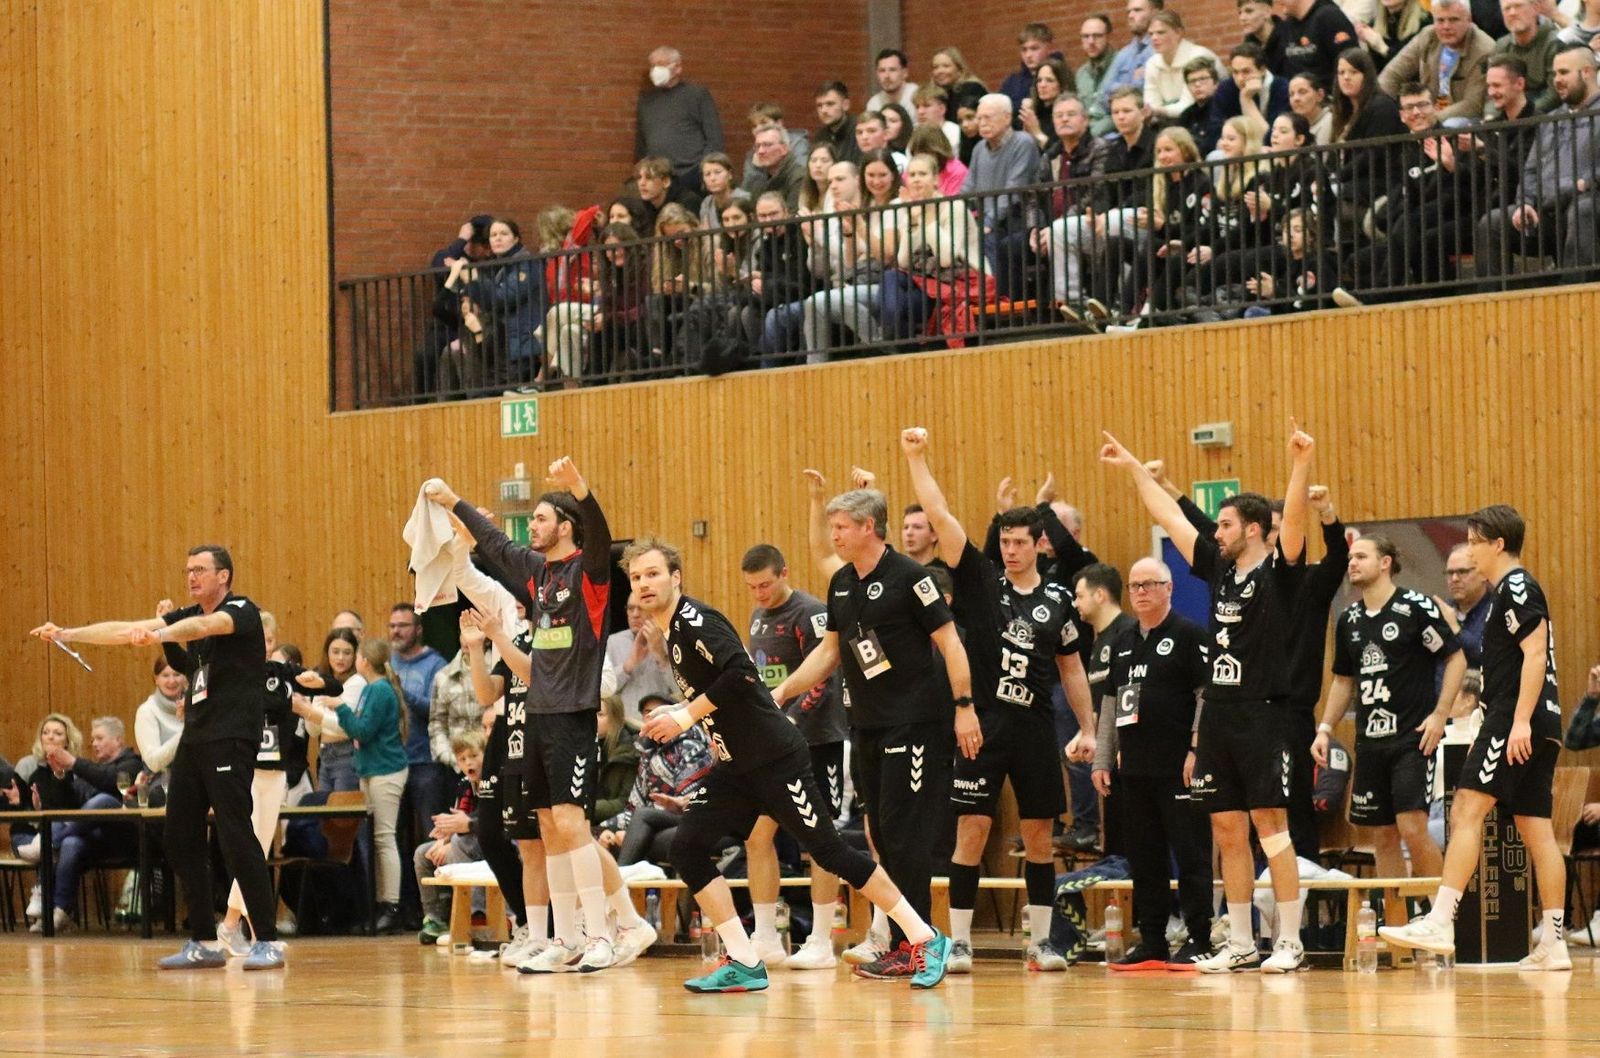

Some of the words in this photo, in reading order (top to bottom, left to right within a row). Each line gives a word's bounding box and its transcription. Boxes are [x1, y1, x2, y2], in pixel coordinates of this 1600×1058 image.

[1216, 627, 1230, 649] 4
[857, 640, 877, 664] B
[1001, 647, 1029, 678] 13
[195, 670, 205, 691] A
[1360, 678, 1391, 705] 24
[1121, 690, 1135, 712] C
[507, 702, 525, 726] 34
[261, 729, 275, 749] D
[1483, 806, 1500, 921] SCHLEREI
